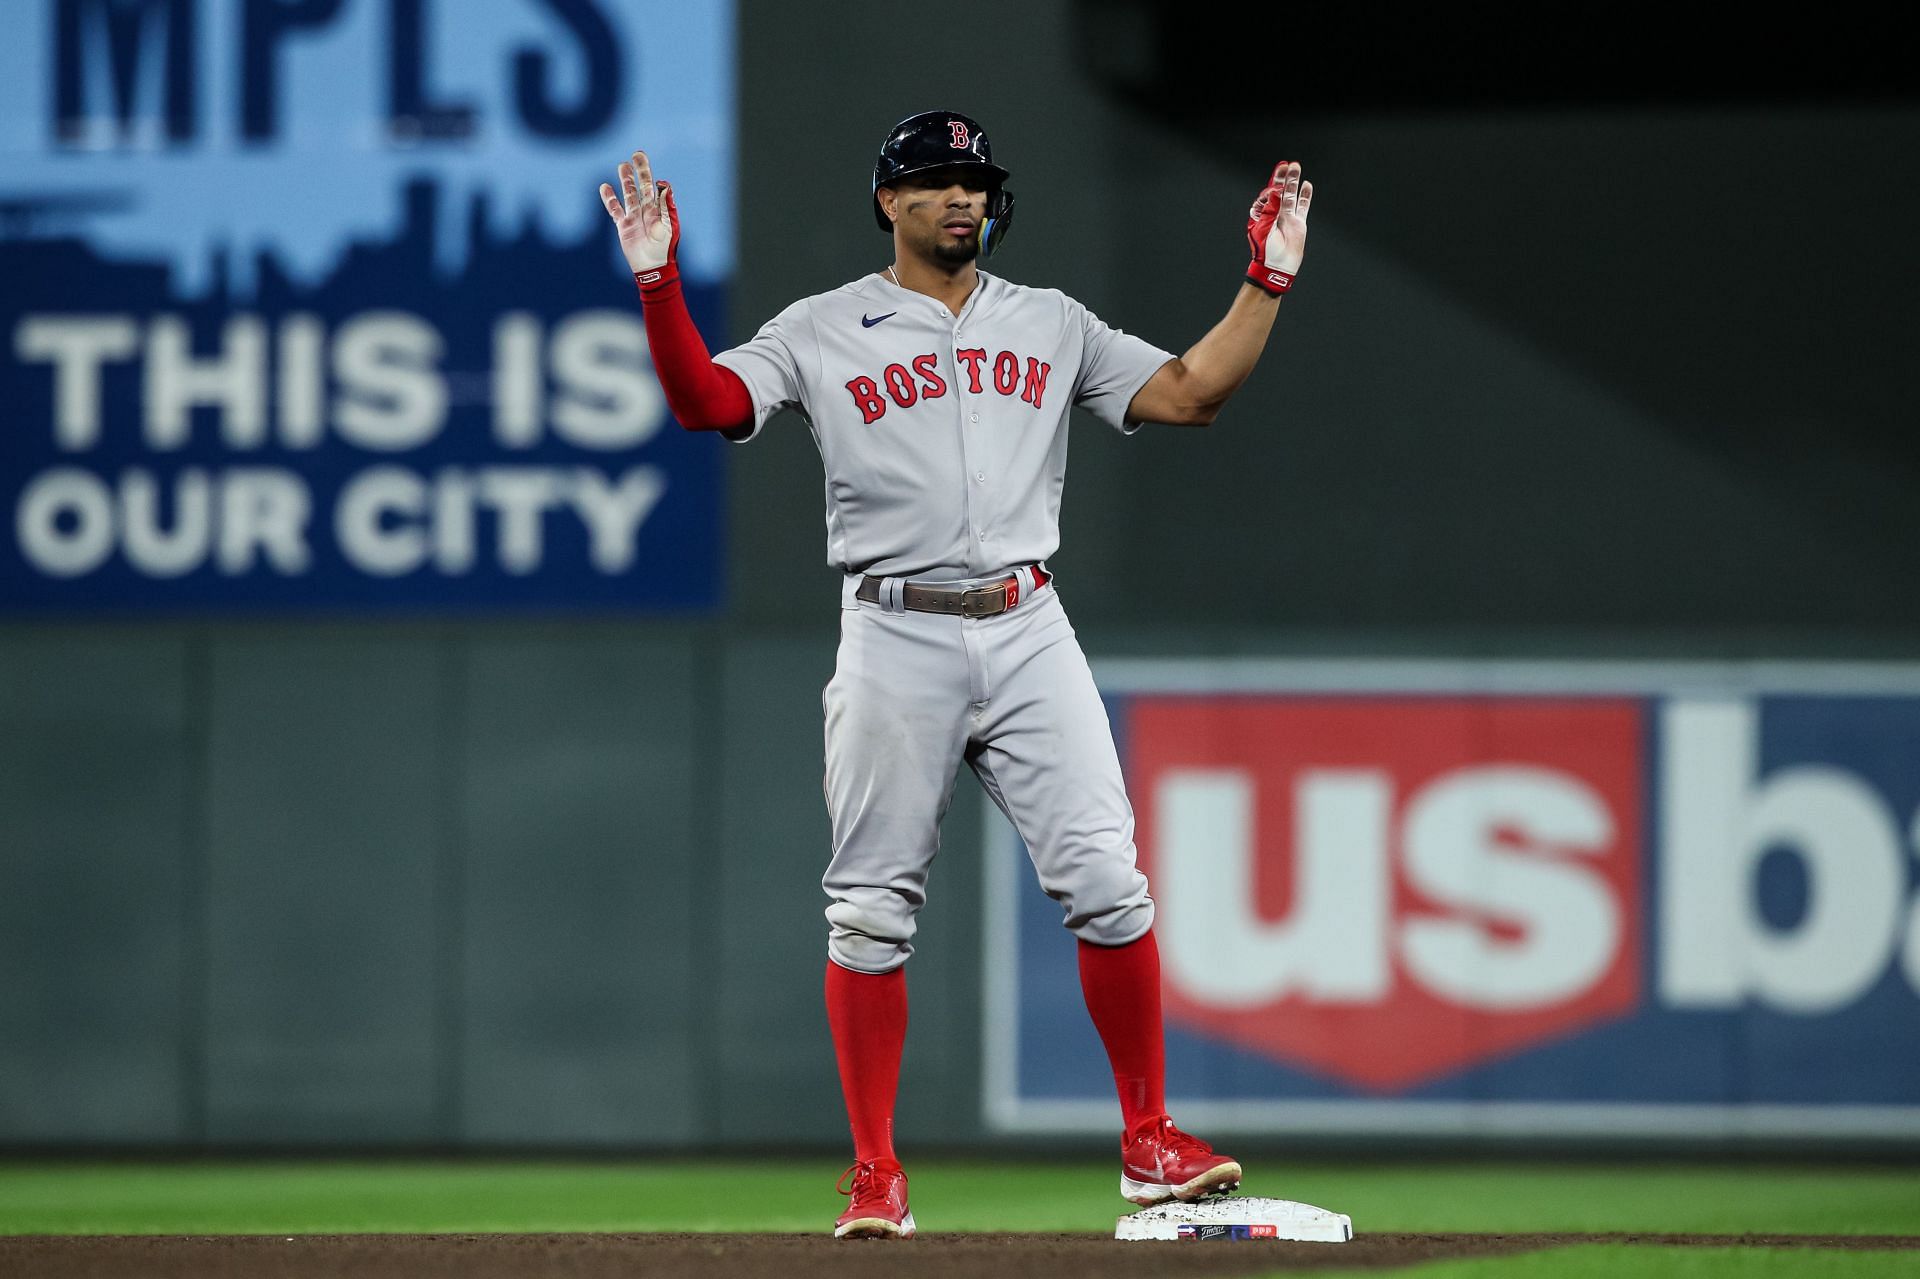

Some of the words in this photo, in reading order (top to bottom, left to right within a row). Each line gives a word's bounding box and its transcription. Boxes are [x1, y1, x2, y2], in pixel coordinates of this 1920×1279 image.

[947, 121, 970, 149] B
[18, 314, 448, 450] THIS
[492, 314, 666, 450] IS
[845, 347, 1051, 424] BOSTON
[17, 468, 310, 575] OUR
[335, 468, 661, 575] CITY
[1009, 590, 1017, 607] 2
[1154, 762, 1623, 1012] us
